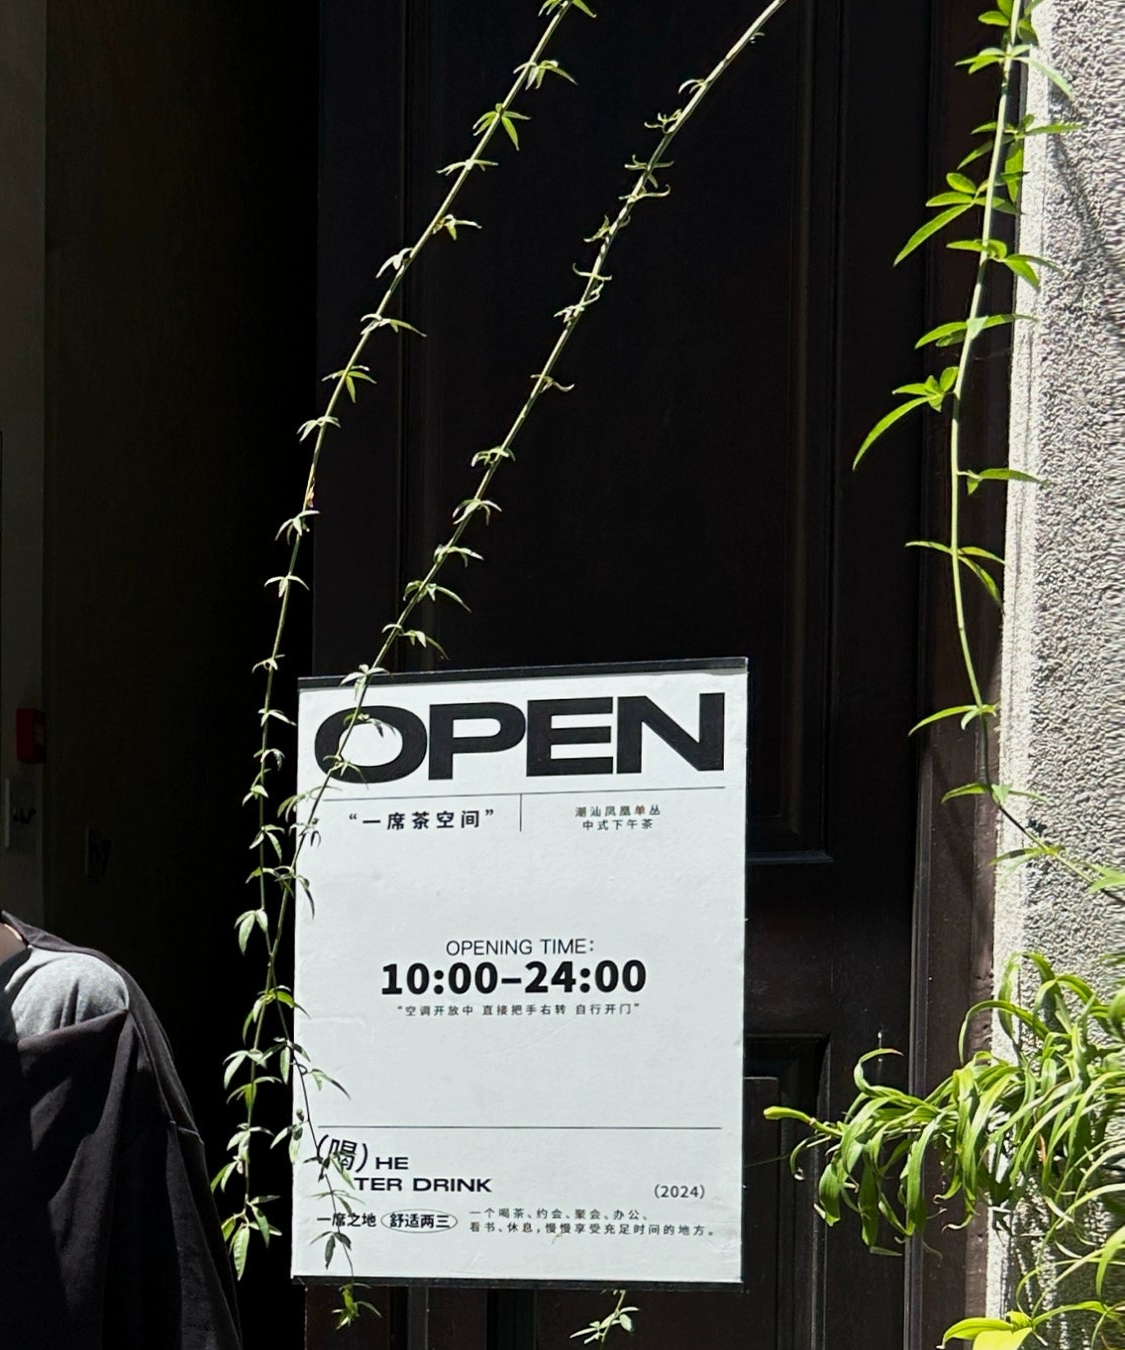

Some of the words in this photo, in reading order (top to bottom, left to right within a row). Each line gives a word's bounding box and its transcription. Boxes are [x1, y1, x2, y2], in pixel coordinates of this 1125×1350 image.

[314, 692, 726, 784] OPEN
[574, 804, 661, 818] 潮汕凤凰单丛
[349, 808, 494, 831] “一席茶空间”
[582, 818, 654, 831] 中式下午茶
[445, 938, 533, 957] OPENING
[539, 938, 594, 955] TIME:
[483, 1004, 566, 1016] 直接把手右转
[375, 1156, 409, 1171] HE
[412, 1177, 492, 1193] DRINK
[654, 1183, 706, 1200] (2024)
[317, 1212, 377, 1228] 一席之地
[389, 1213, 450, 1228] 舒适两三
